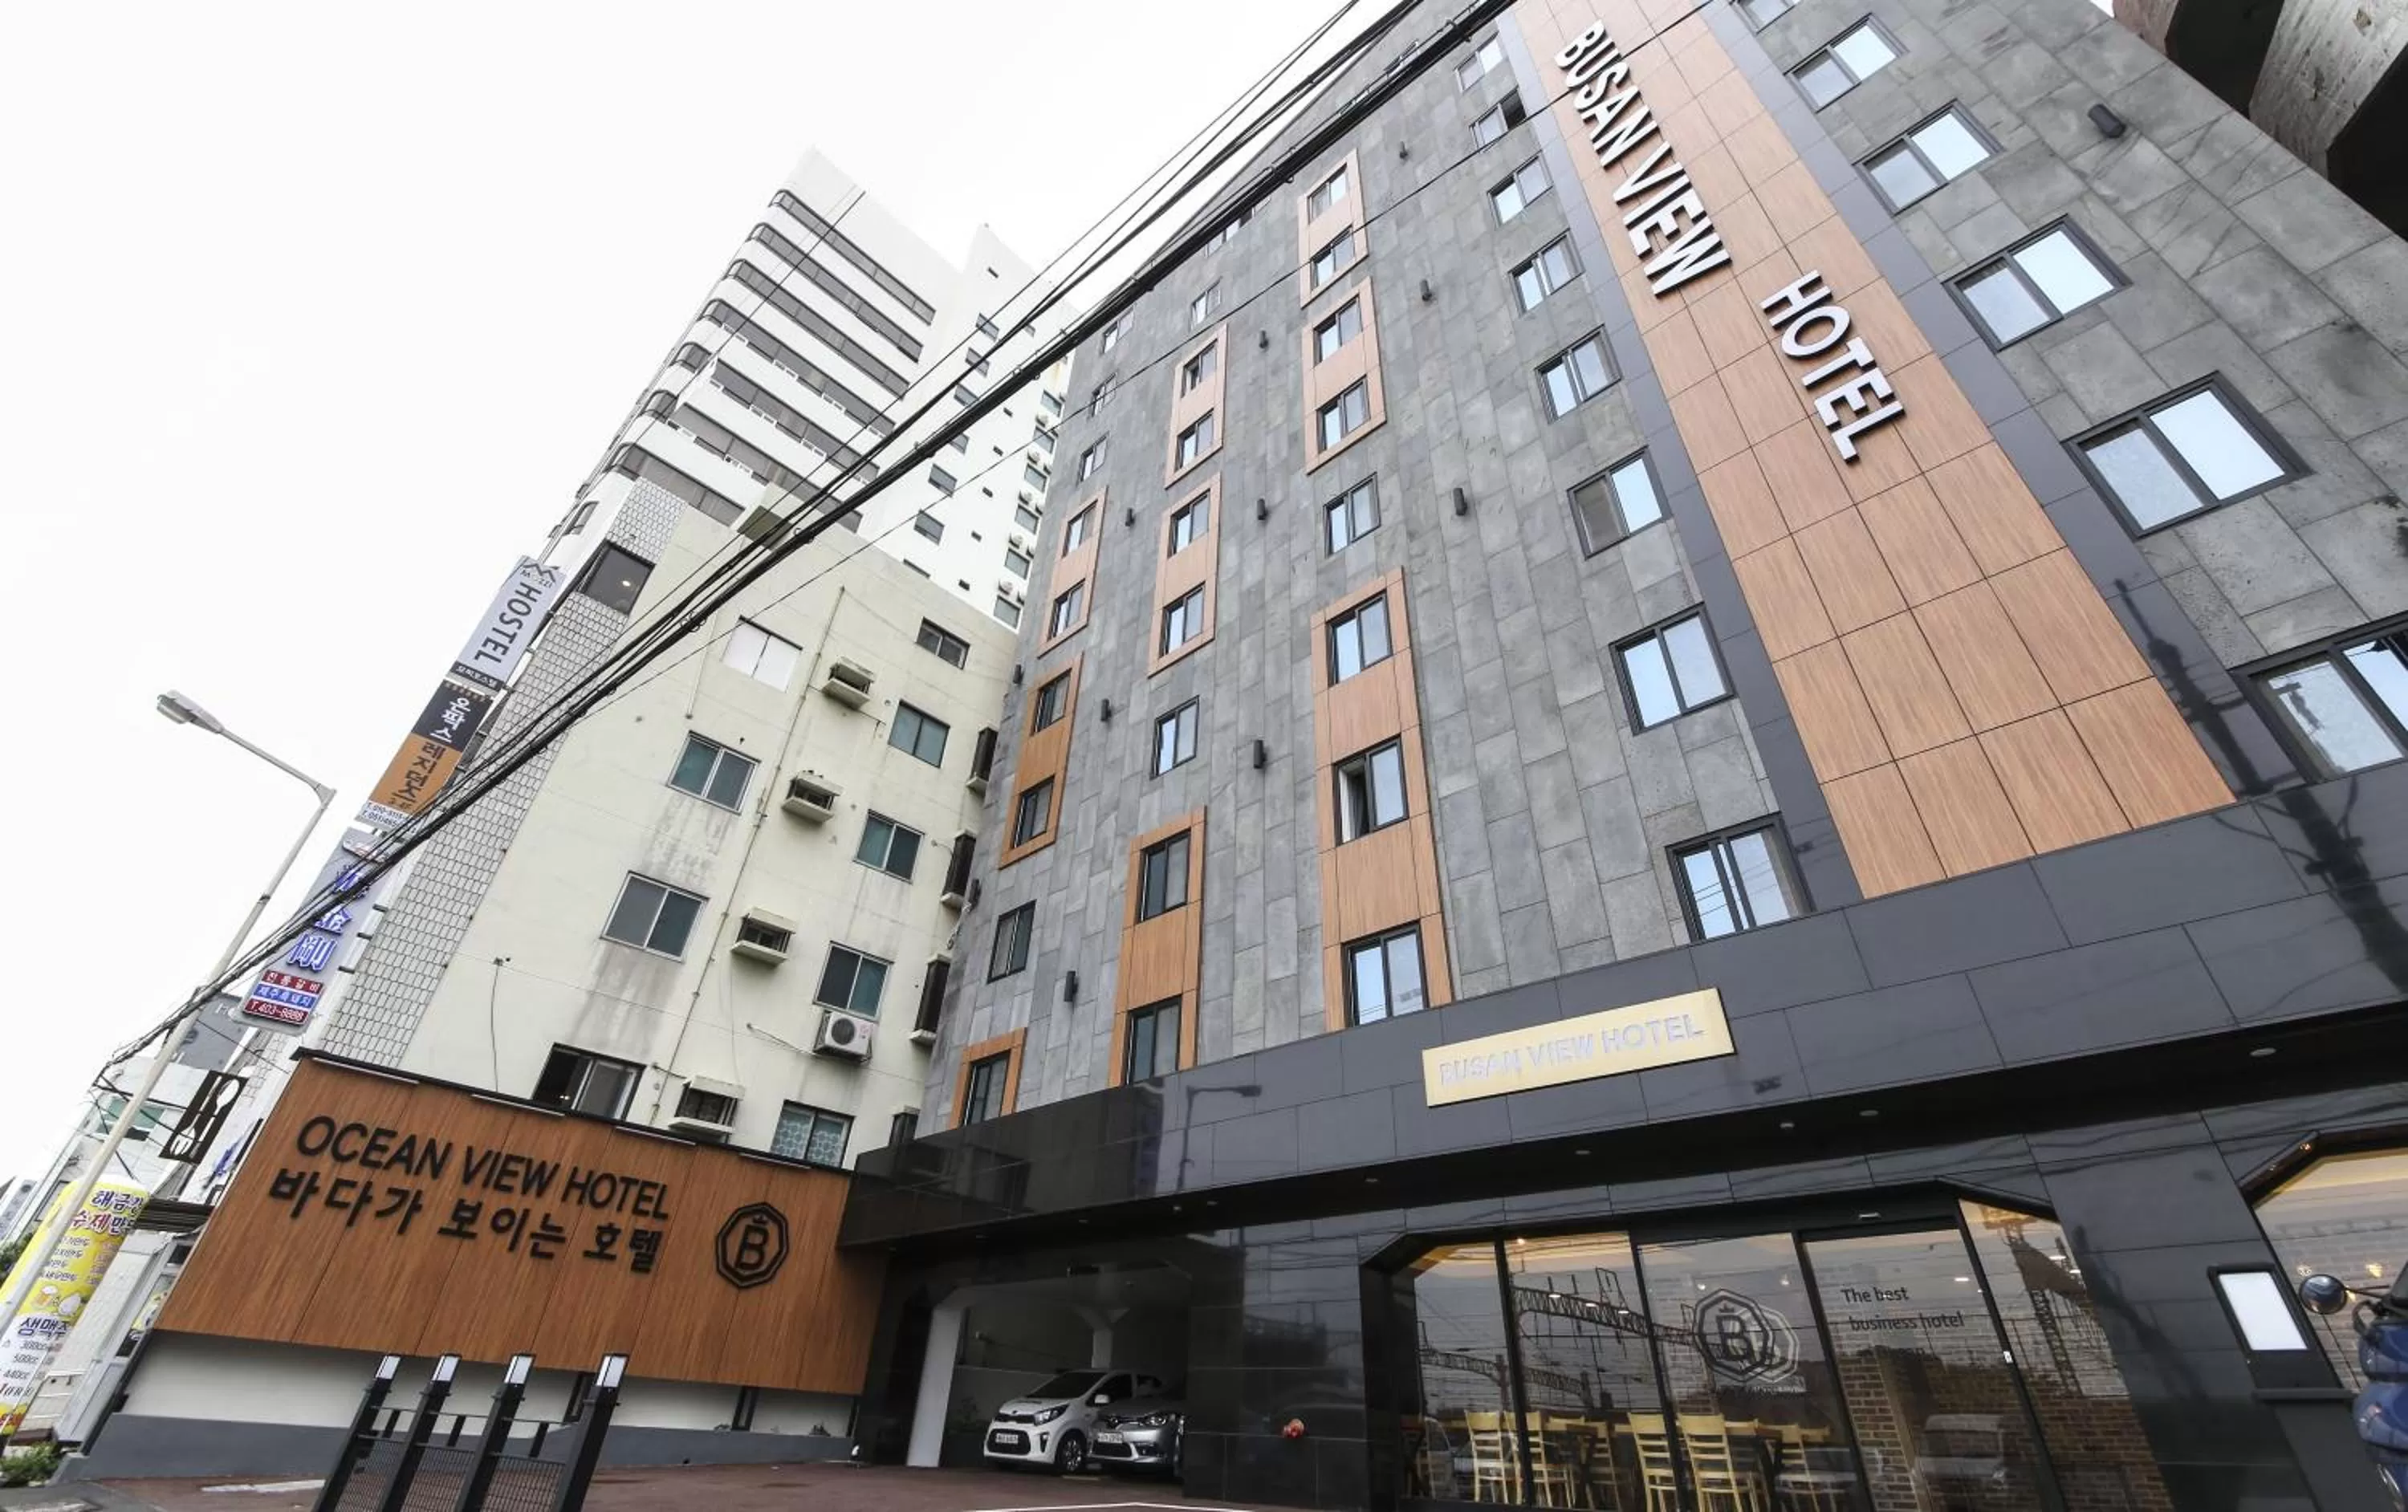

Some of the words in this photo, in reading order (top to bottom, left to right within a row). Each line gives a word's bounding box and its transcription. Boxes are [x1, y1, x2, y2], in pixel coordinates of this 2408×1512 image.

[1554, 18, 1660, 170] BUSAN
[1613, 141, 1732, 299] VIEW
[1759, 270, 1907, 464] HOTEL
[474, 582, 543, 664] HOSTEL
[1439, 1048, 1521, 1086] BUSAN
[1526, 1033, 1594, 1067] VIEW
[1601, 1014, 1706, 1054] HOTEL
[297, 1116, 453, 1181] OCEAN
[460, 1144, 560, 1200] VIEW
[562, 1165, 669, 1221] HOTEL
[268, 1168, 423, 1235] 바다가
[438, 1199, 567, 1261] 보이는
[583, 1222, 663, 1274] 호텔
[1841, 1286, 1873, 1304] The
[1873, 1286, 1910, 1302] best
[1849, 1313, 1918, 1331] business
[1918, 1309, 1965, 1330] hotel
